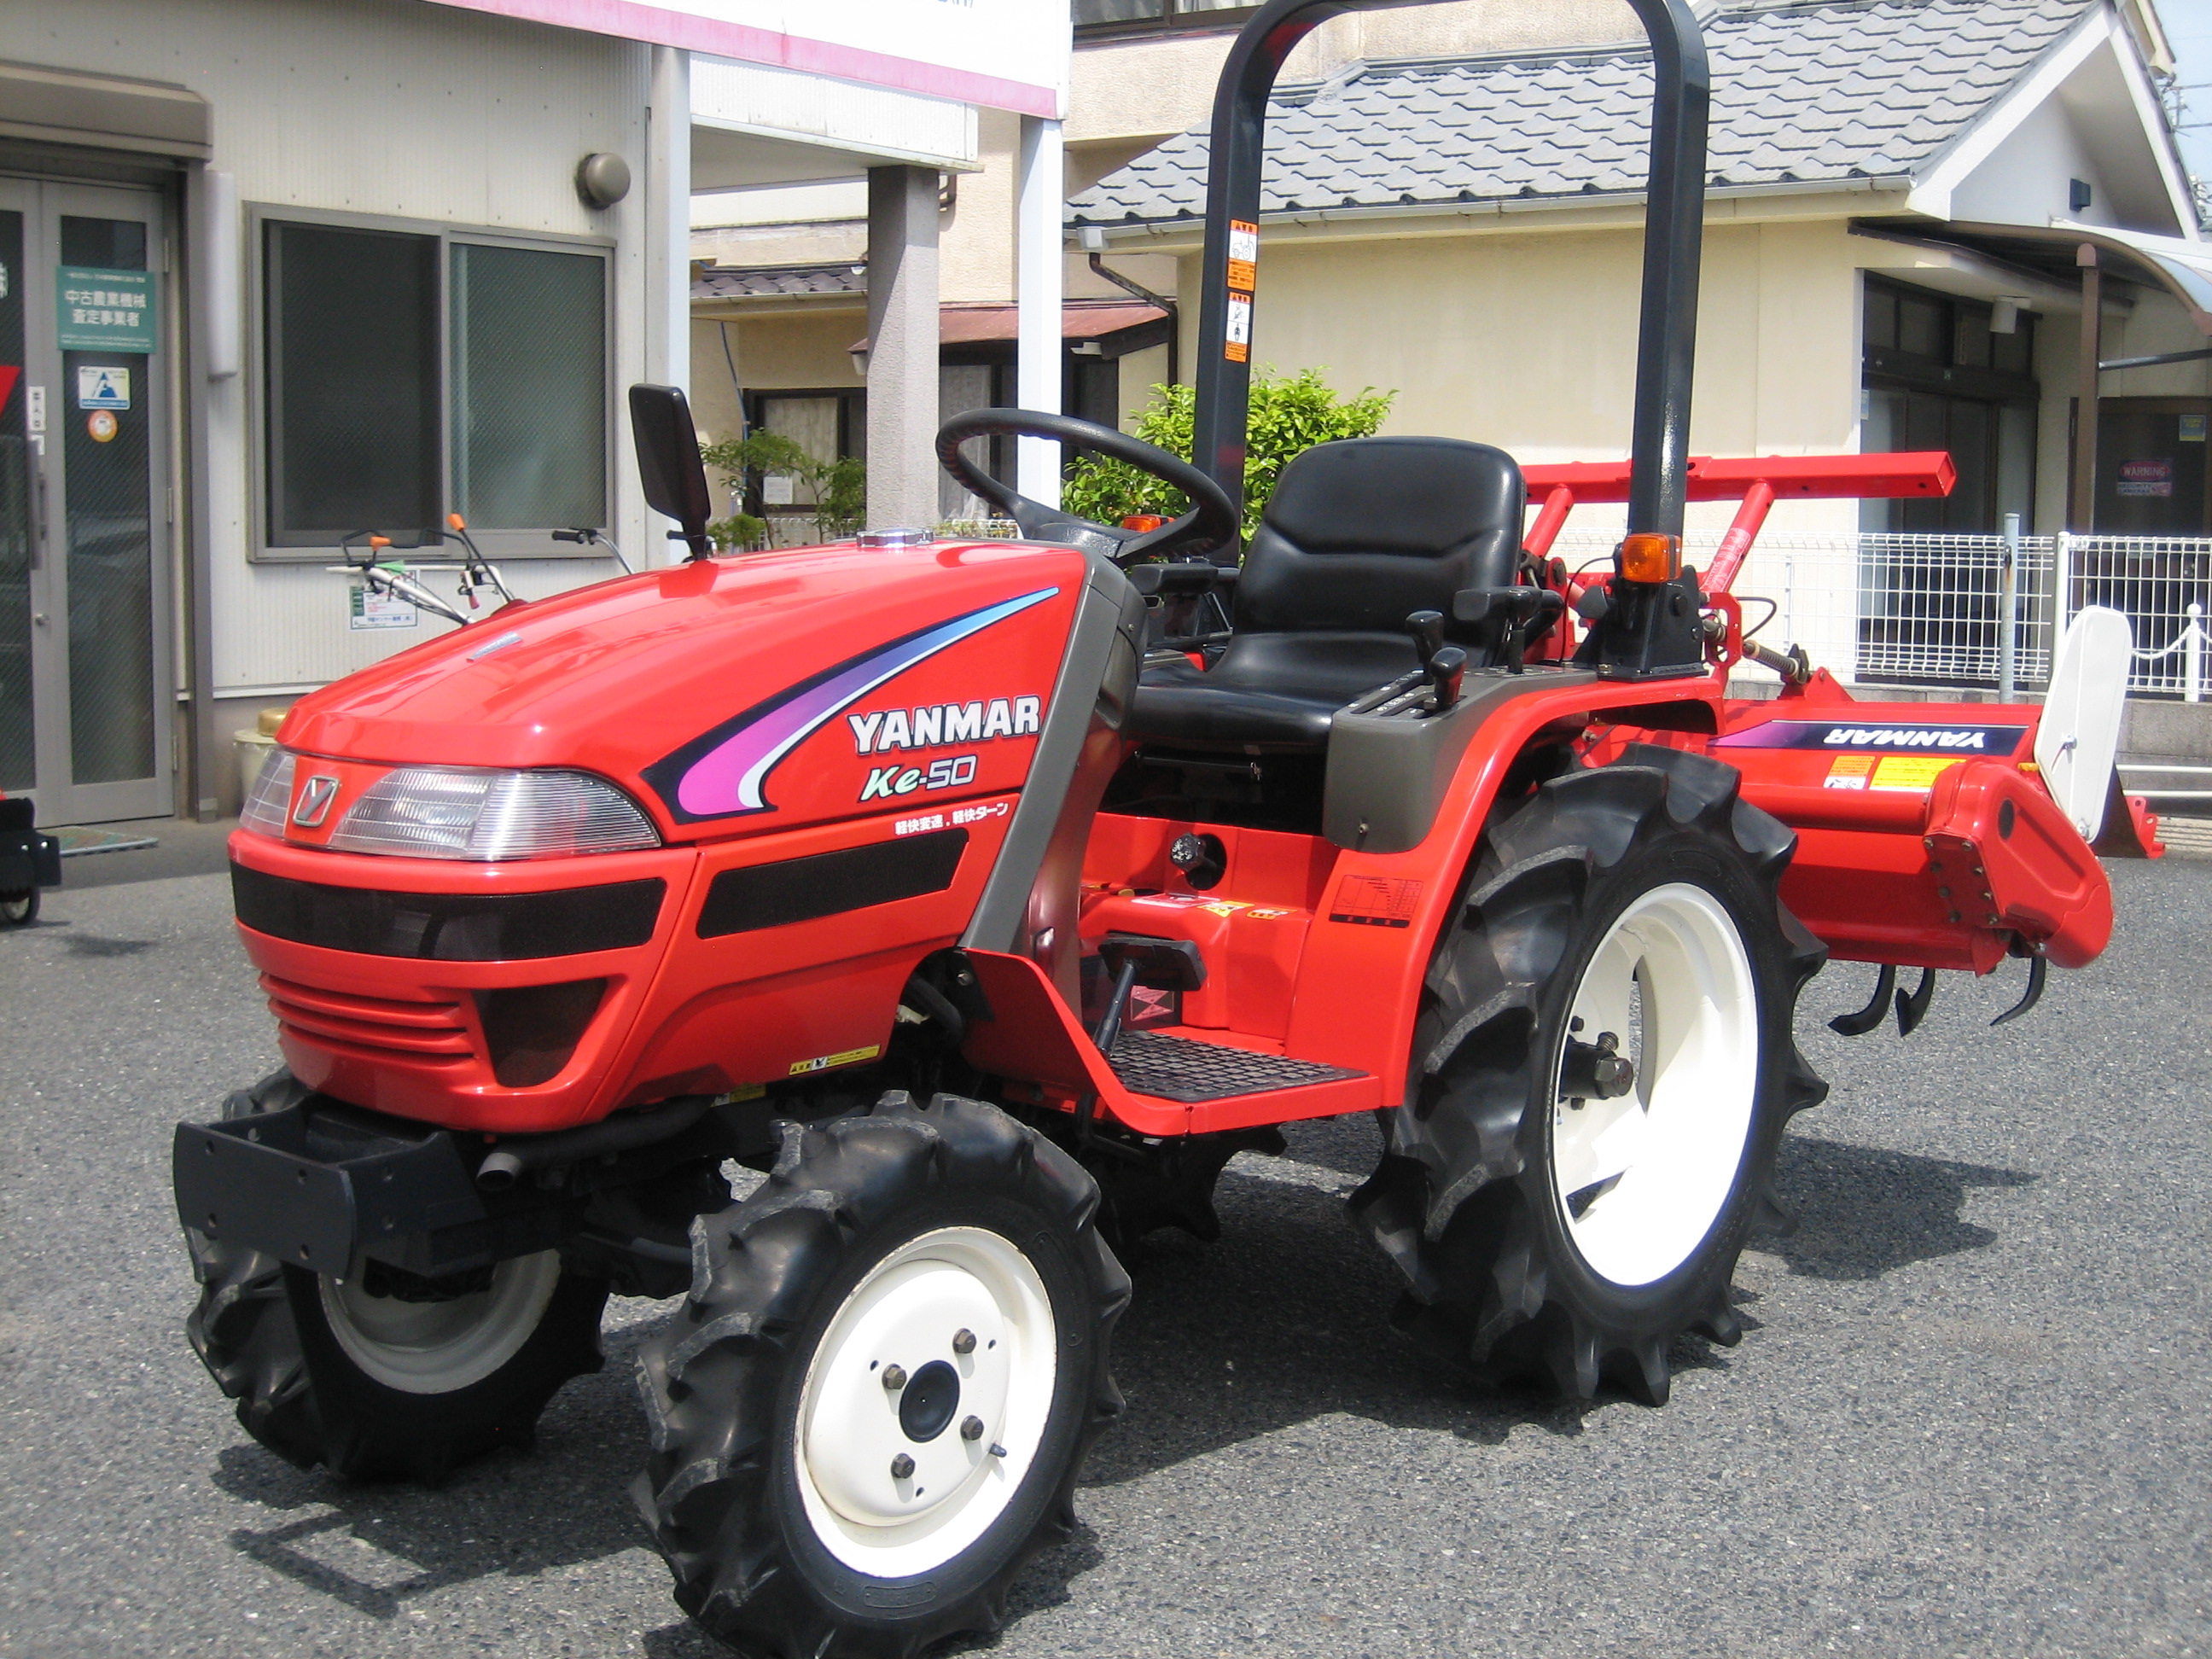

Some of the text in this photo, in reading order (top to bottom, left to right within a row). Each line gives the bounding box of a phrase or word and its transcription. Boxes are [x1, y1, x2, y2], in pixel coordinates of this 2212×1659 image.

[2122, 466, 2165, 477] WARNING
[847, 696, 1040, 754] YANMAR
[1823, 729, 1986, 748] YANMAR
[858, 755, 977, 802] Ke-50
